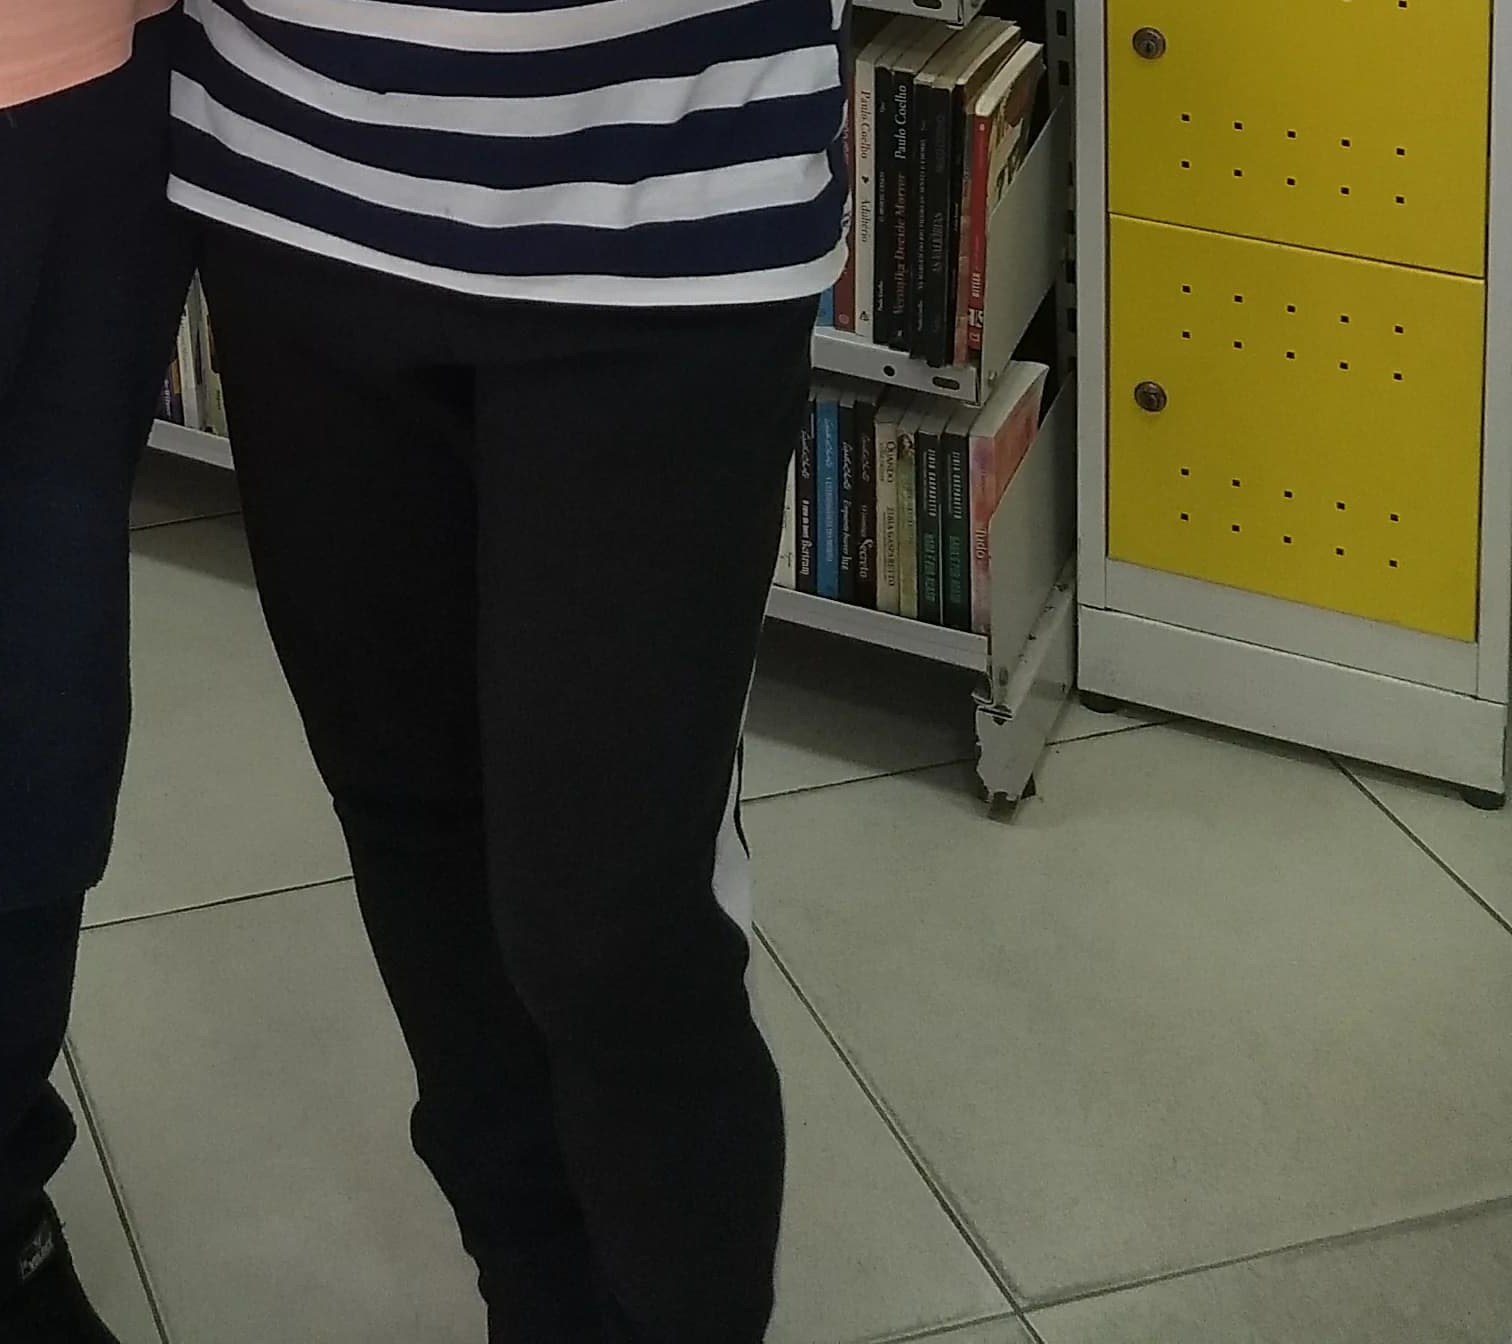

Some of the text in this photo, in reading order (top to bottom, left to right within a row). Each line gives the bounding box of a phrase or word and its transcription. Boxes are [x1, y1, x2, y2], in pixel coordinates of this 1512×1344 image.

[860, 91, 871, 160] Paulo Coelho
[894, 84, 908, 161] Paulo Coelho
